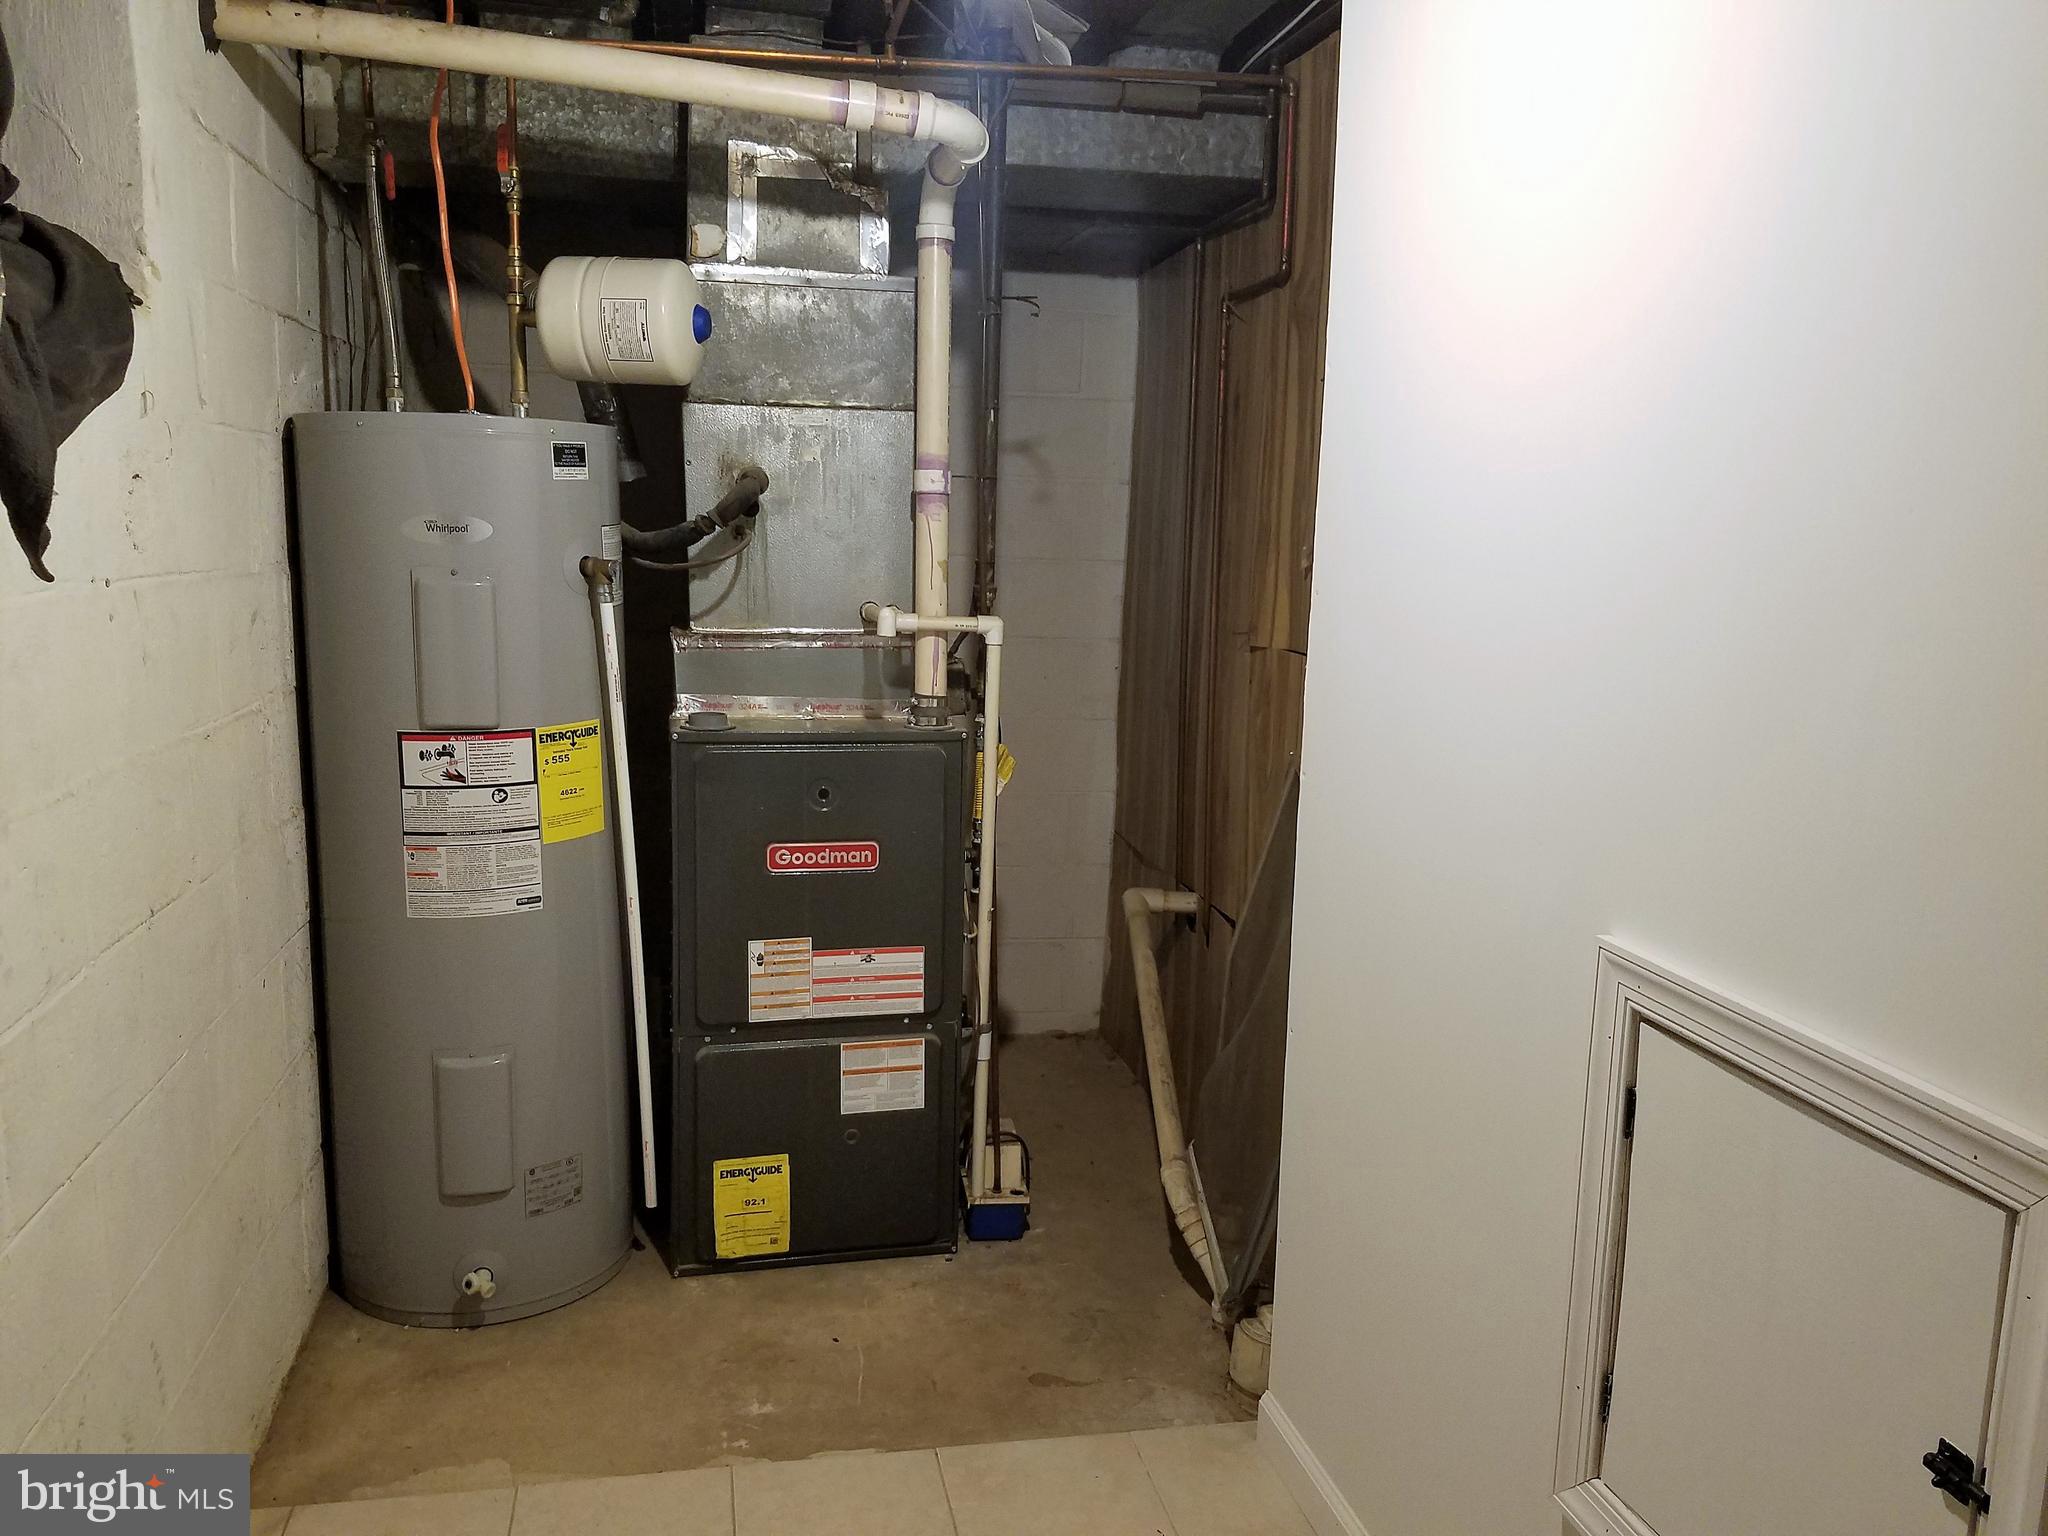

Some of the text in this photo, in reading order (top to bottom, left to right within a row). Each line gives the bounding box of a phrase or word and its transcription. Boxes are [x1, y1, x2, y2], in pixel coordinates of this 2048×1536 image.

[425, 523, 469, 535] Whirlpool
[538, 725, 599, 747] ENERGYGUIDE
[551, 753, 570, 765] 555
[775, 848, 872, 865] Goodman
[720, 1165, 783, 1182] ENERGYGUIDE
[744, 1198, 766, 1206] 92.1
